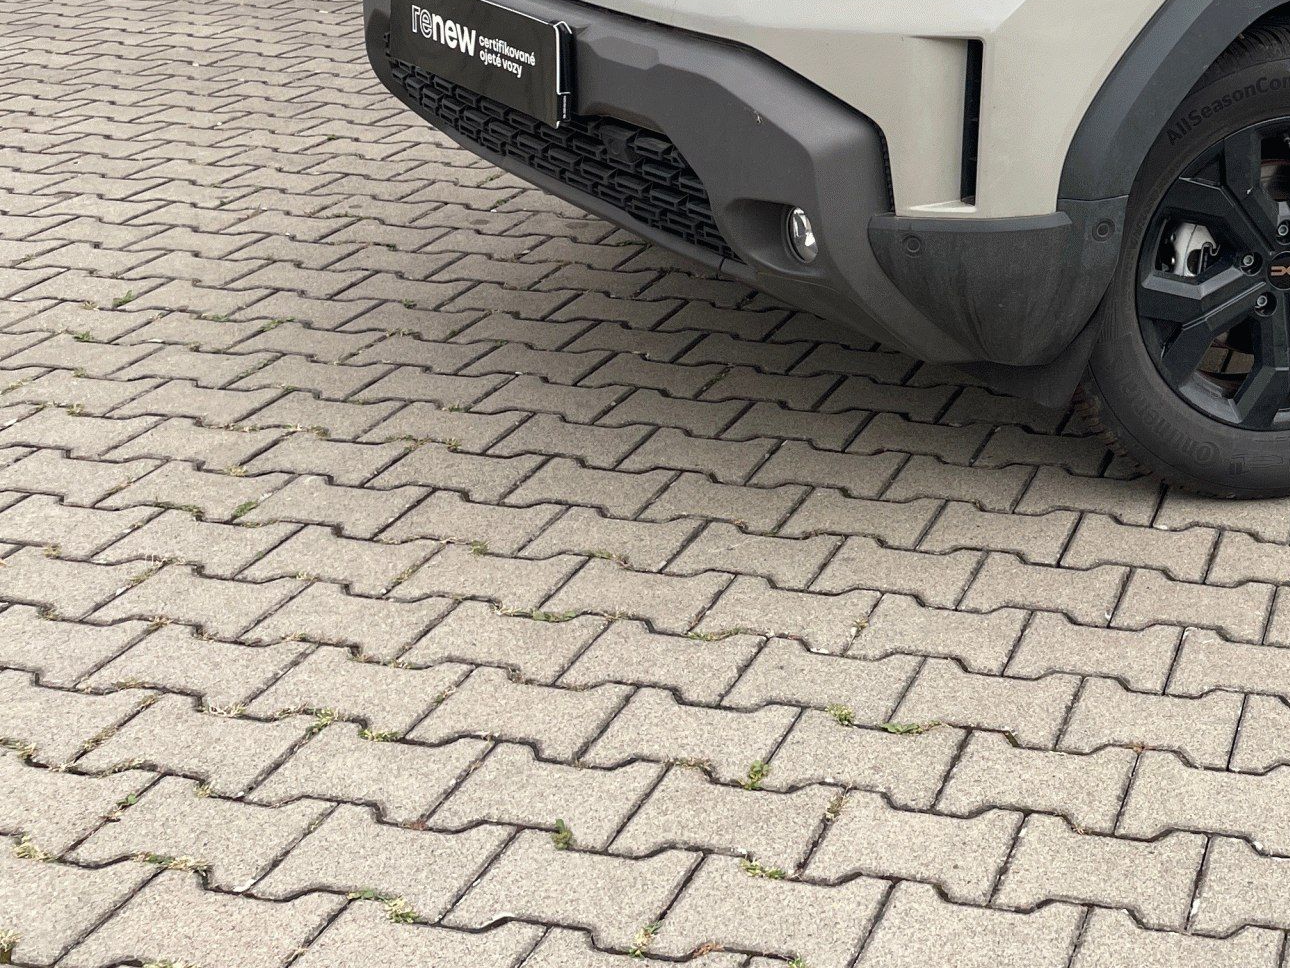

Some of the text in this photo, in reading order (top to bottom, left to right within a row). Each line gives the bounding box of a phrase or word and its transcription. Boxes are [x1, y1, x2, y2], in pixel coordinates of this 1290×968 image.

[411, 4, 477, 57] renew
[479, 35, 536, 66] certifikované
[479, 49, 523, 78] ojeté vozy
